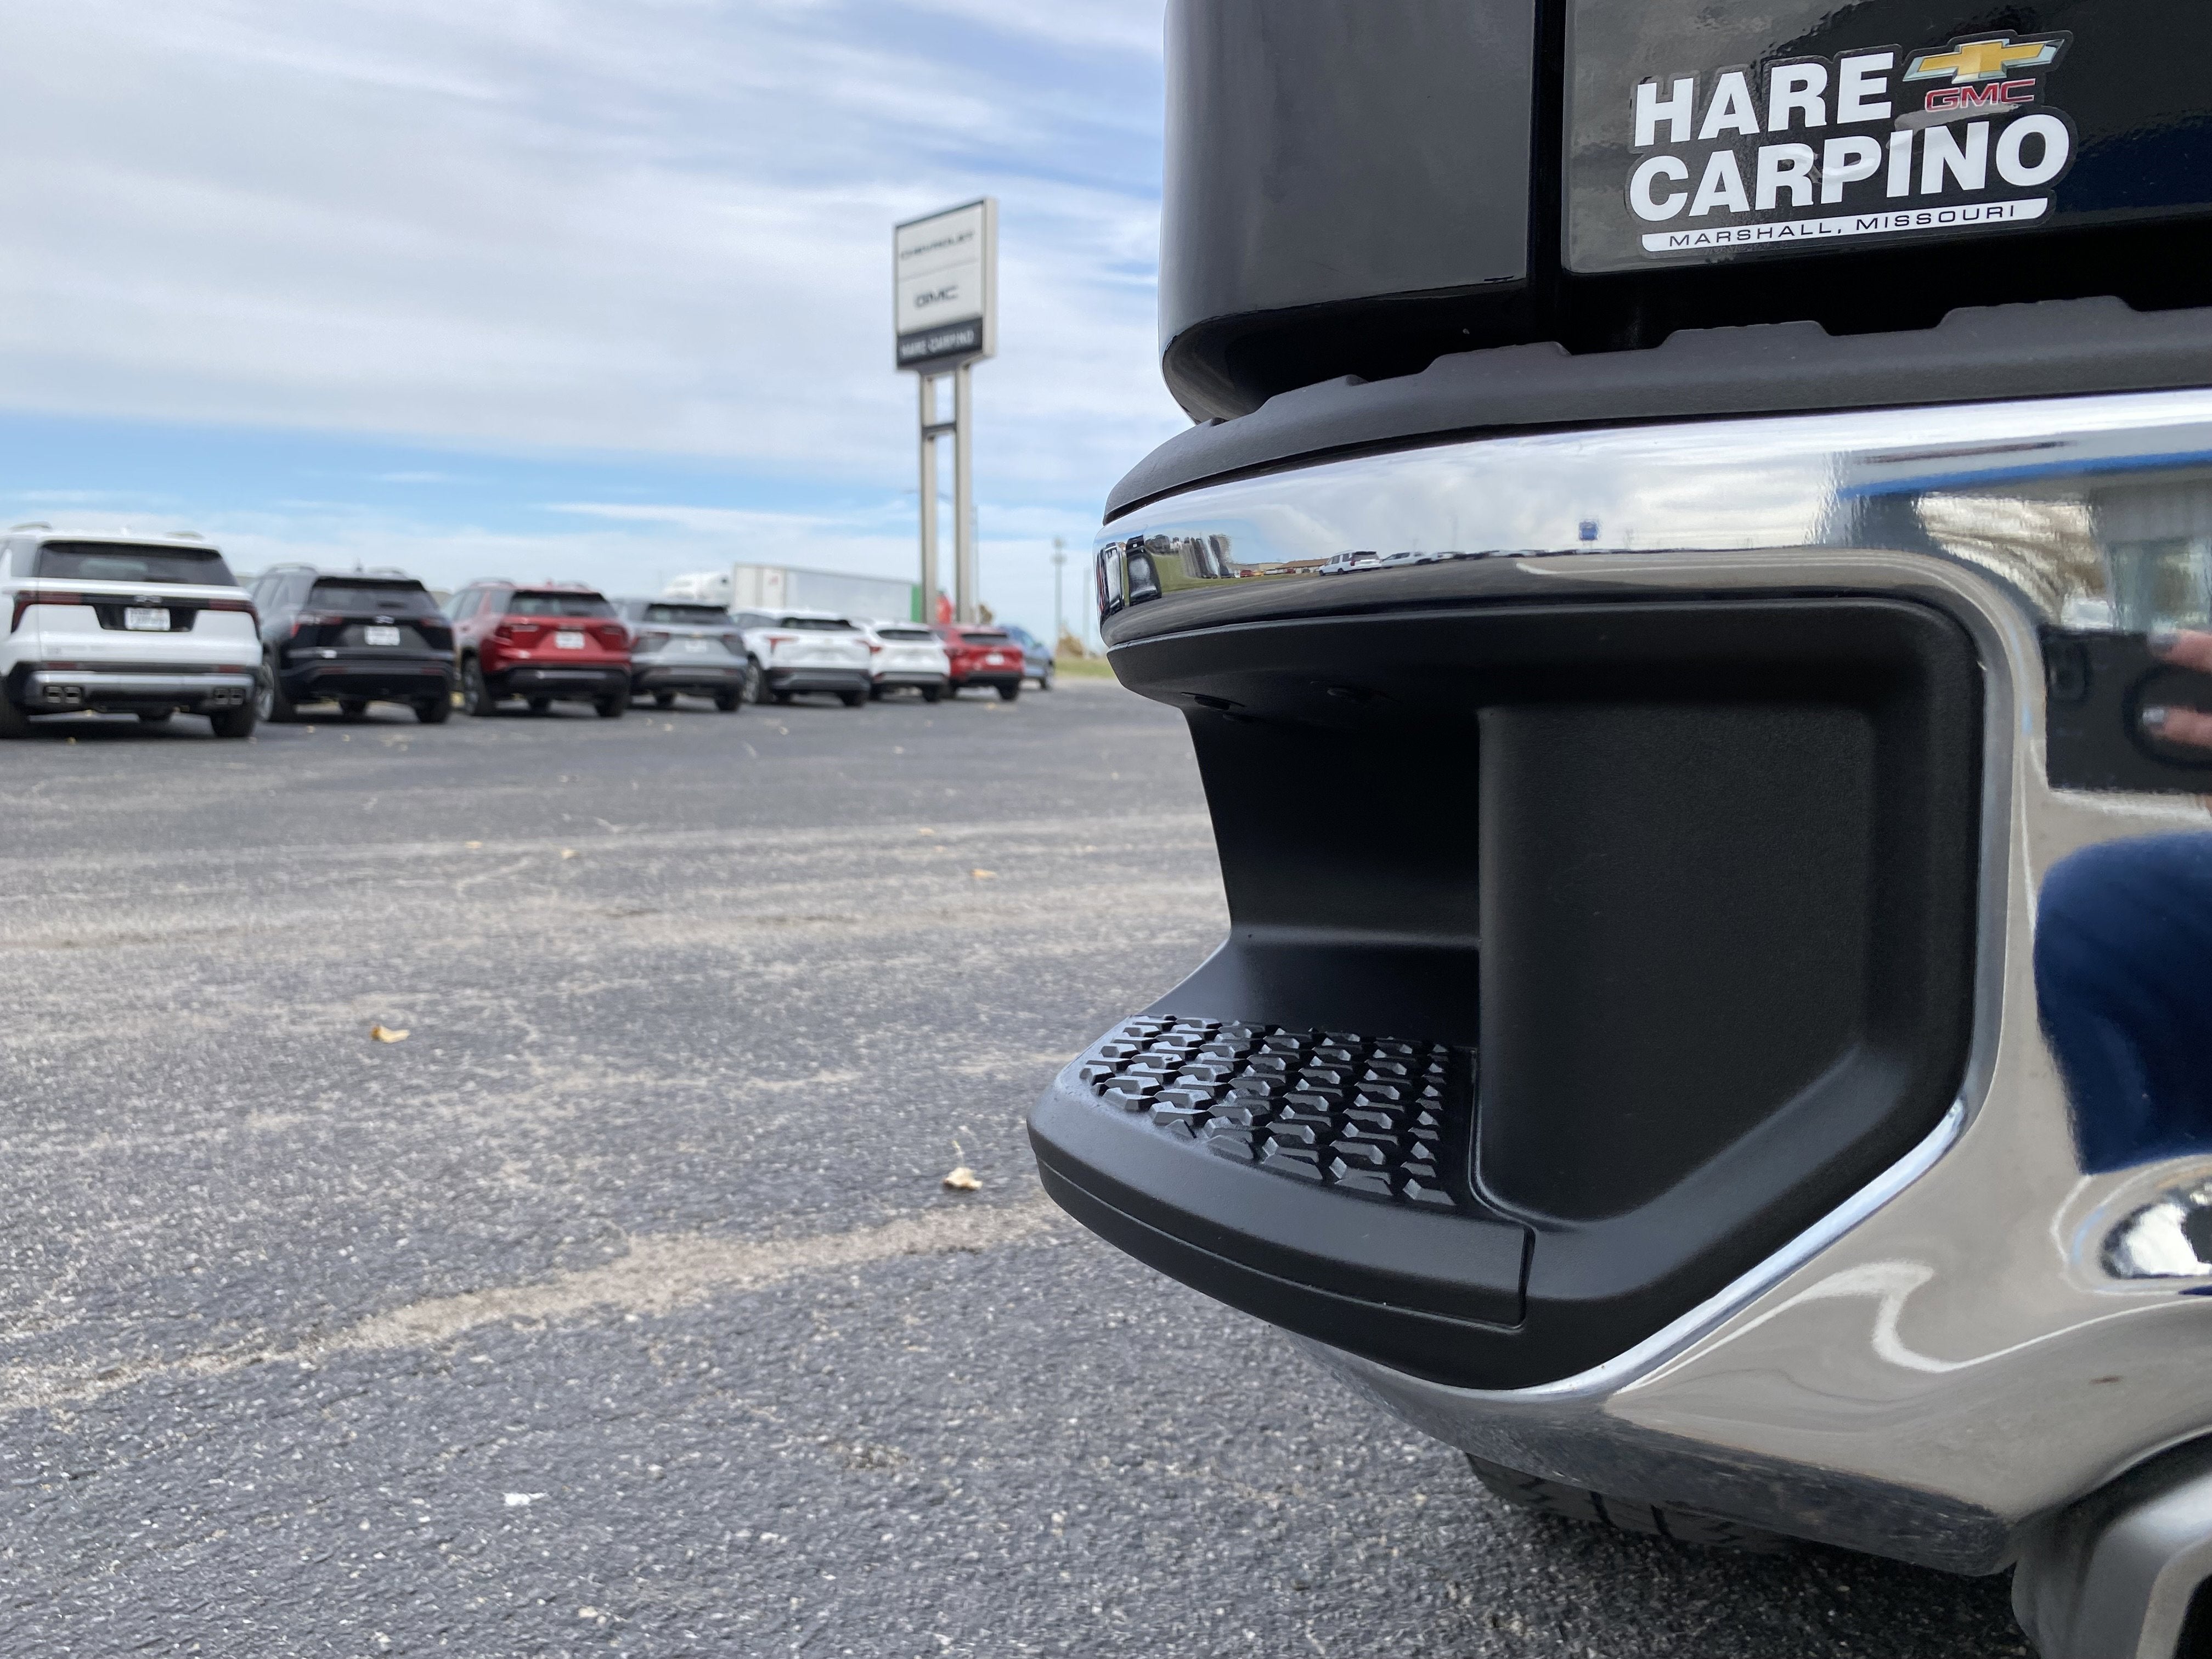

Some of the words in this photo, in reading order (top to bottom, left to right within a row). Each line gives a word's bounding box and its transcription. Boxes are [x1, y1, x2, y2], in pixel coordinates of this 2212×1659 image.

[1633, 52, 1895, 148] HARE
[1924, 78, 2036, 112] GMC
[1629, 114, 2070, 222] CARPINO
[1668, 223, 1842, 247] MARSHALL,
[1855, 205, 2016, 230] MISSOURI
[915, 285, 957, 307] GMC
